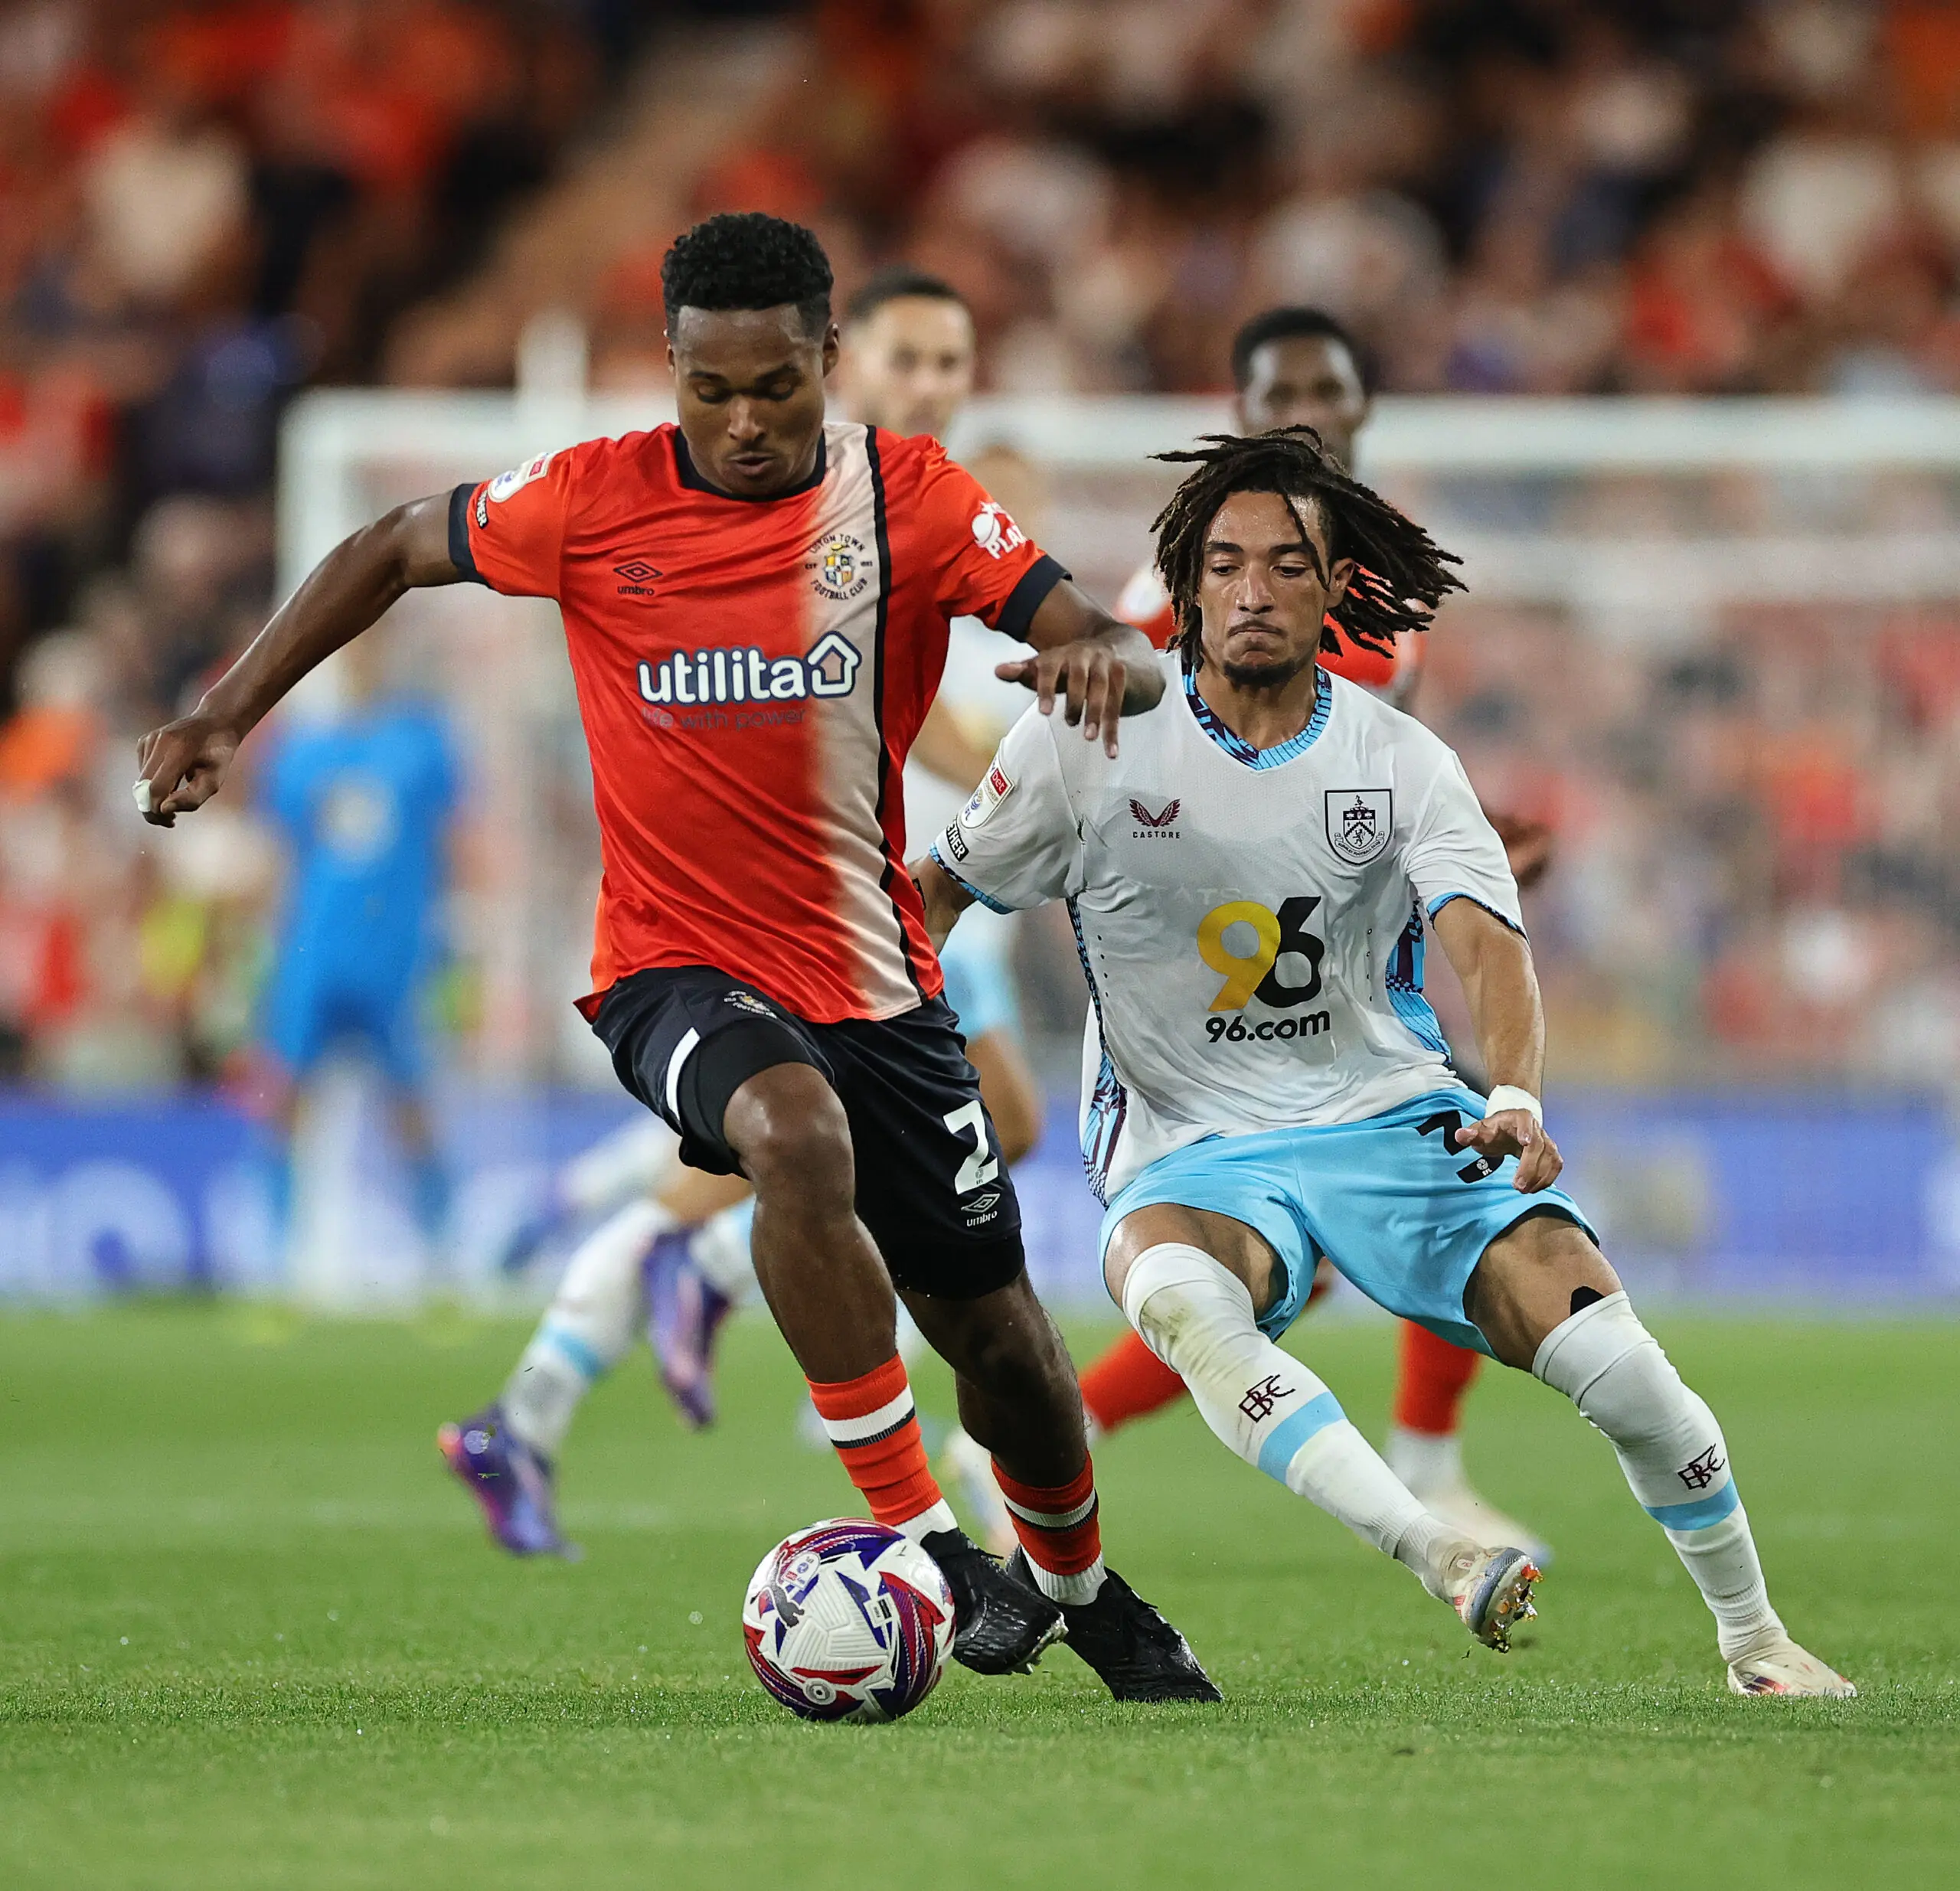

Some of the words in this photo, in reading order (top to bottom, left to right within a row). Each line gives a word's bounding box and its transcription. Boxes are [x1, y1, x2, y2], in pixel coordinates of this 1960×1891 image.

[840, 533, 865, 552] TOWN
[616, 585, 655, 596] umbro
[810, 579, 848, 600] FOOTBALL
[849, 577, 867, 596] CLUB
[637, 647, 807, 704] utilita
[680, 710, 727, 728] with
[735, 709, 805, 731] power
[992, 770, 1004, 792] bet
[947, 821, 965, 858] ETHER
[1132, 831, 1181, 839] CASTORE
[1197, 896, 1325, 1012] 96
[1205, 1011, 1331, 1043] 96.com
[943, 1099, 998, 1195] 2
[966, 1210, 998, 1226] umbro
